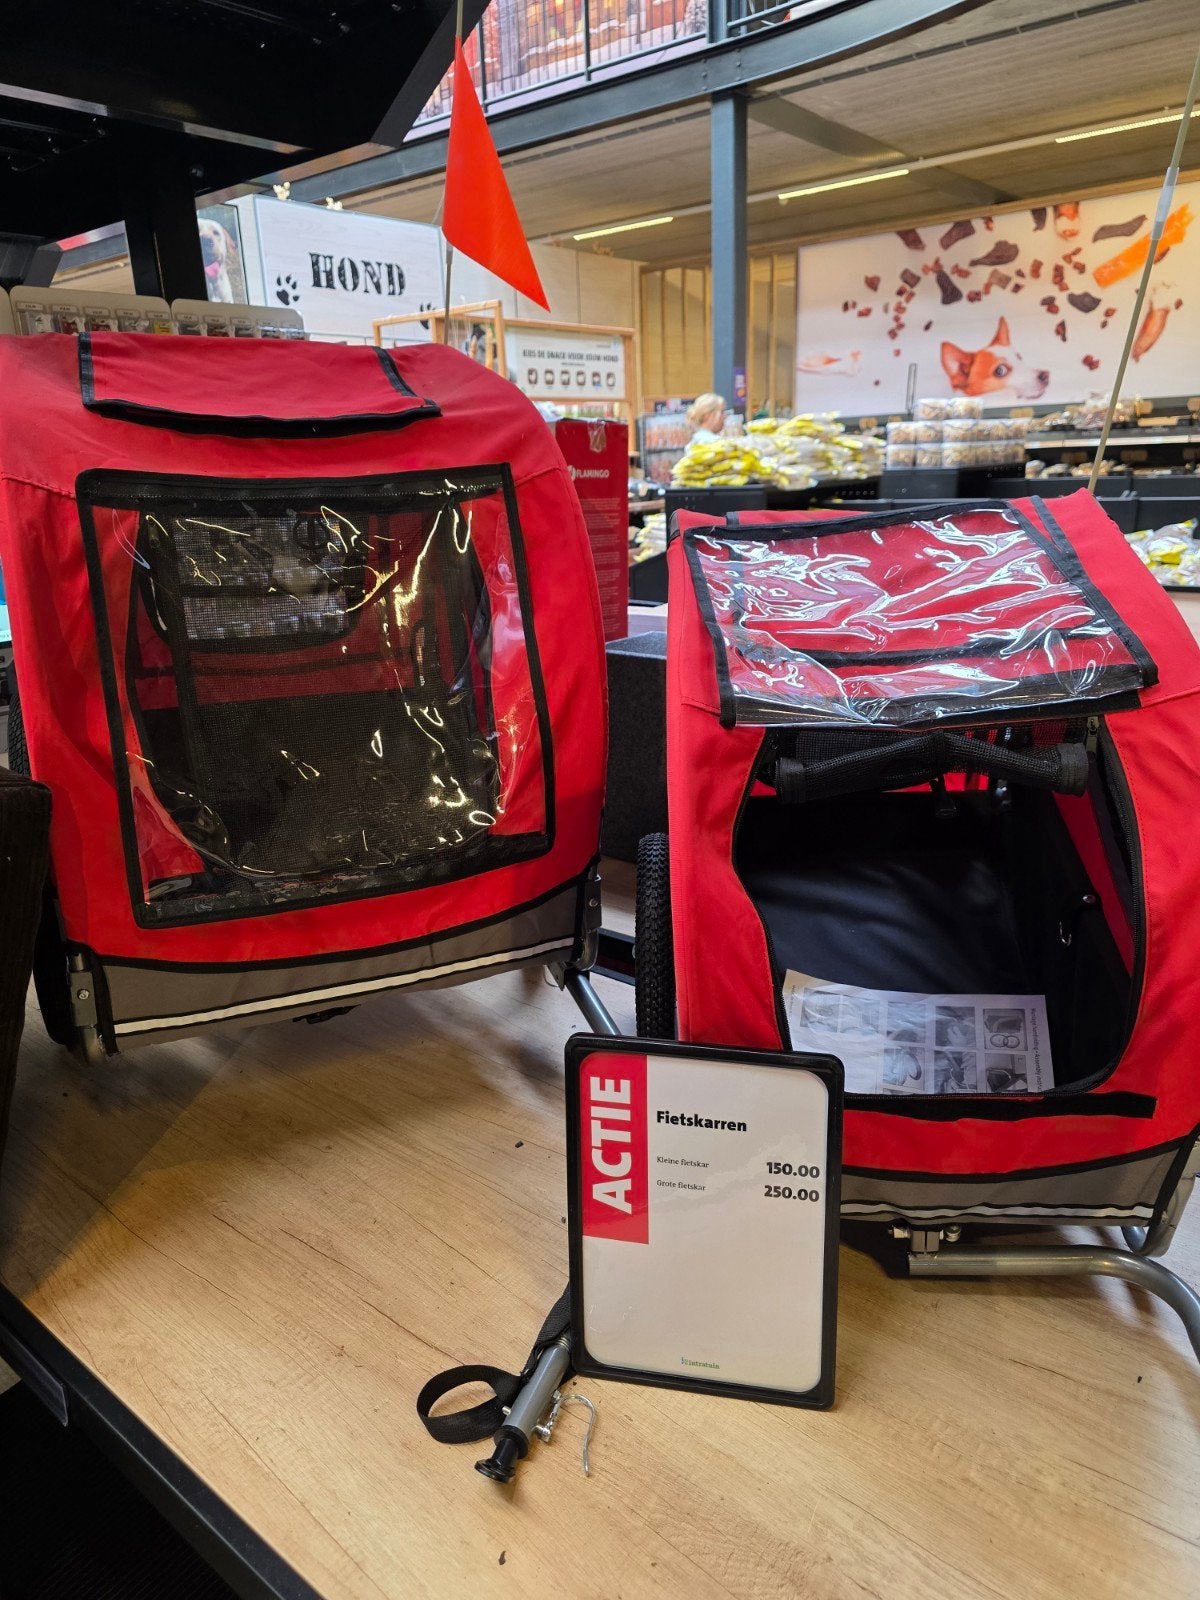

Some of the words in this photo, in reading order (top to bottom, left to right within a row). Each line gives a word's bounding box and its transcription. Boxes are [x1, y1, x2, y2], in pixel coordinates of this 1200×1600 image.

[309, 252, 406, 296] HOND
[576, 469, 610, 479] FLAMINGO
[656, 1110, 748, 1132] Fietskarren
[590, 1076, 632, 1215] ACTIE
[656, 1156, 679, 1166] Kleine
[680, 1159, 710, 1169] fietskar
[766, 1161, 820, 1179] 150.00
[656, 1179, 677, 1189] Grote
[678, 1181, 706, 1192] fietskar
[764, 1185, 820, 1203] 250.00
